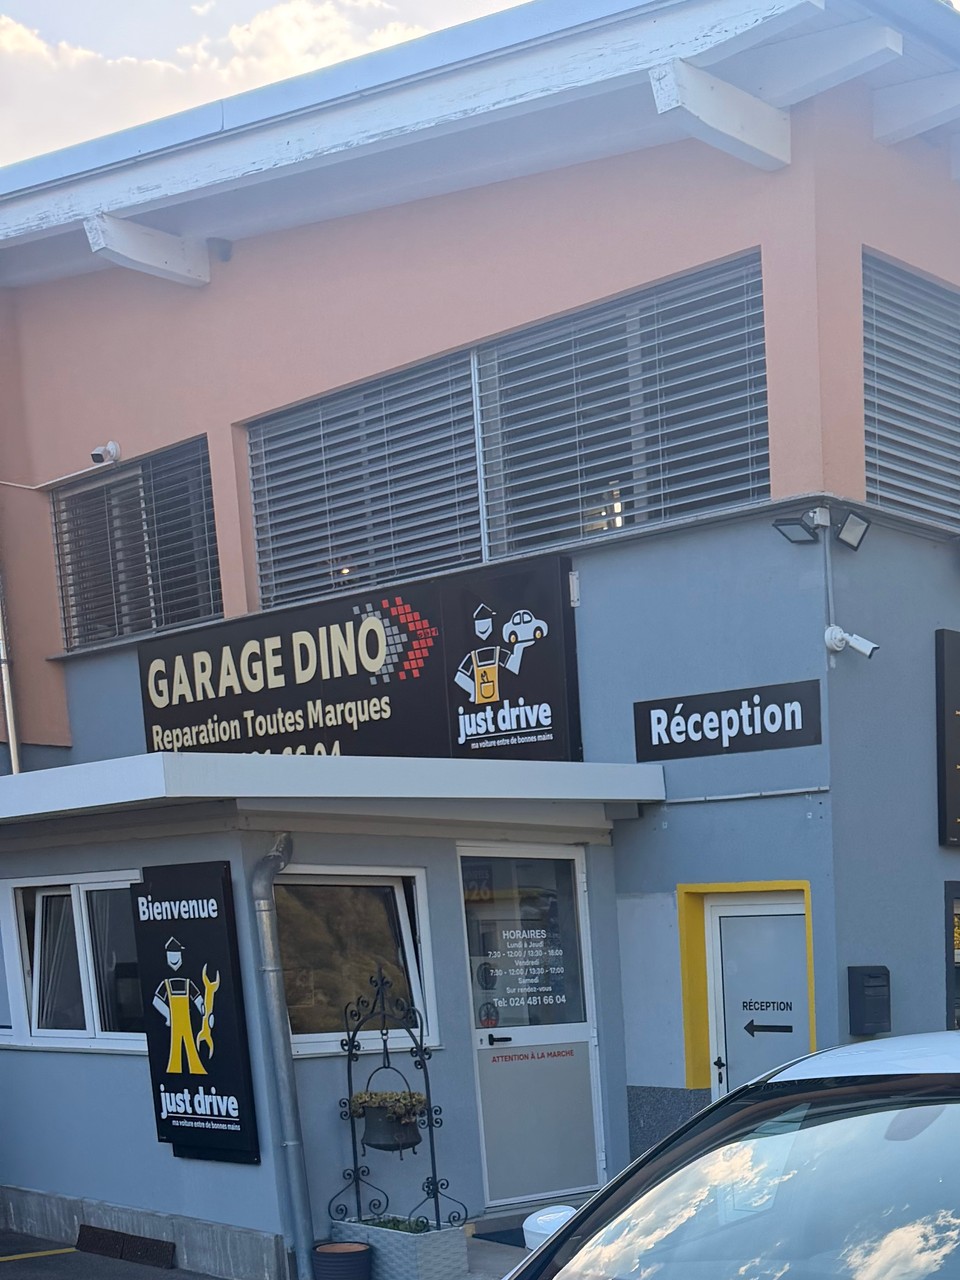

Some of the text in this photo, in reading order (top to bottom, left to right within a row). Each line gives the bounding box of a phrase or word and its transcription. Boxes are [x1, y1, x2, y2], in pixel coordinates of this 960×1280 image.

[147, 616, 387, 709] GARAGE DINO
[151, 695, 392, 752] Reparation Toutes Marques
[457, 697, 552, 745] just drive
[650, 694, 803, 748] Réception
[510, 736, 517, 745] de
[517, 735, 537, 744] bonnes
[137, 894, 218, 921] Bienvenue
[502, 929, 547, 940] HORAIRES
[528, 940, 545, 948] Jeudi
[518, 976, 540, 984] Samedi
[506, 986, 516, 994] Sur
[509, 997, 525, 1007] 024
[527, 996, 542, 1005] 481
[543, 995, 554, 1004] 66
[555, 994, 567, 1004] 04
[742, 999, 793, 1011] RÉCEPTION
[491, 1053, 530, 1063] ATTENTION
[537, 1052, 546, 1060] LA
[547, 1049, 575, 1059] MARCHE
[160, 1083, 239, 1119] just drive
